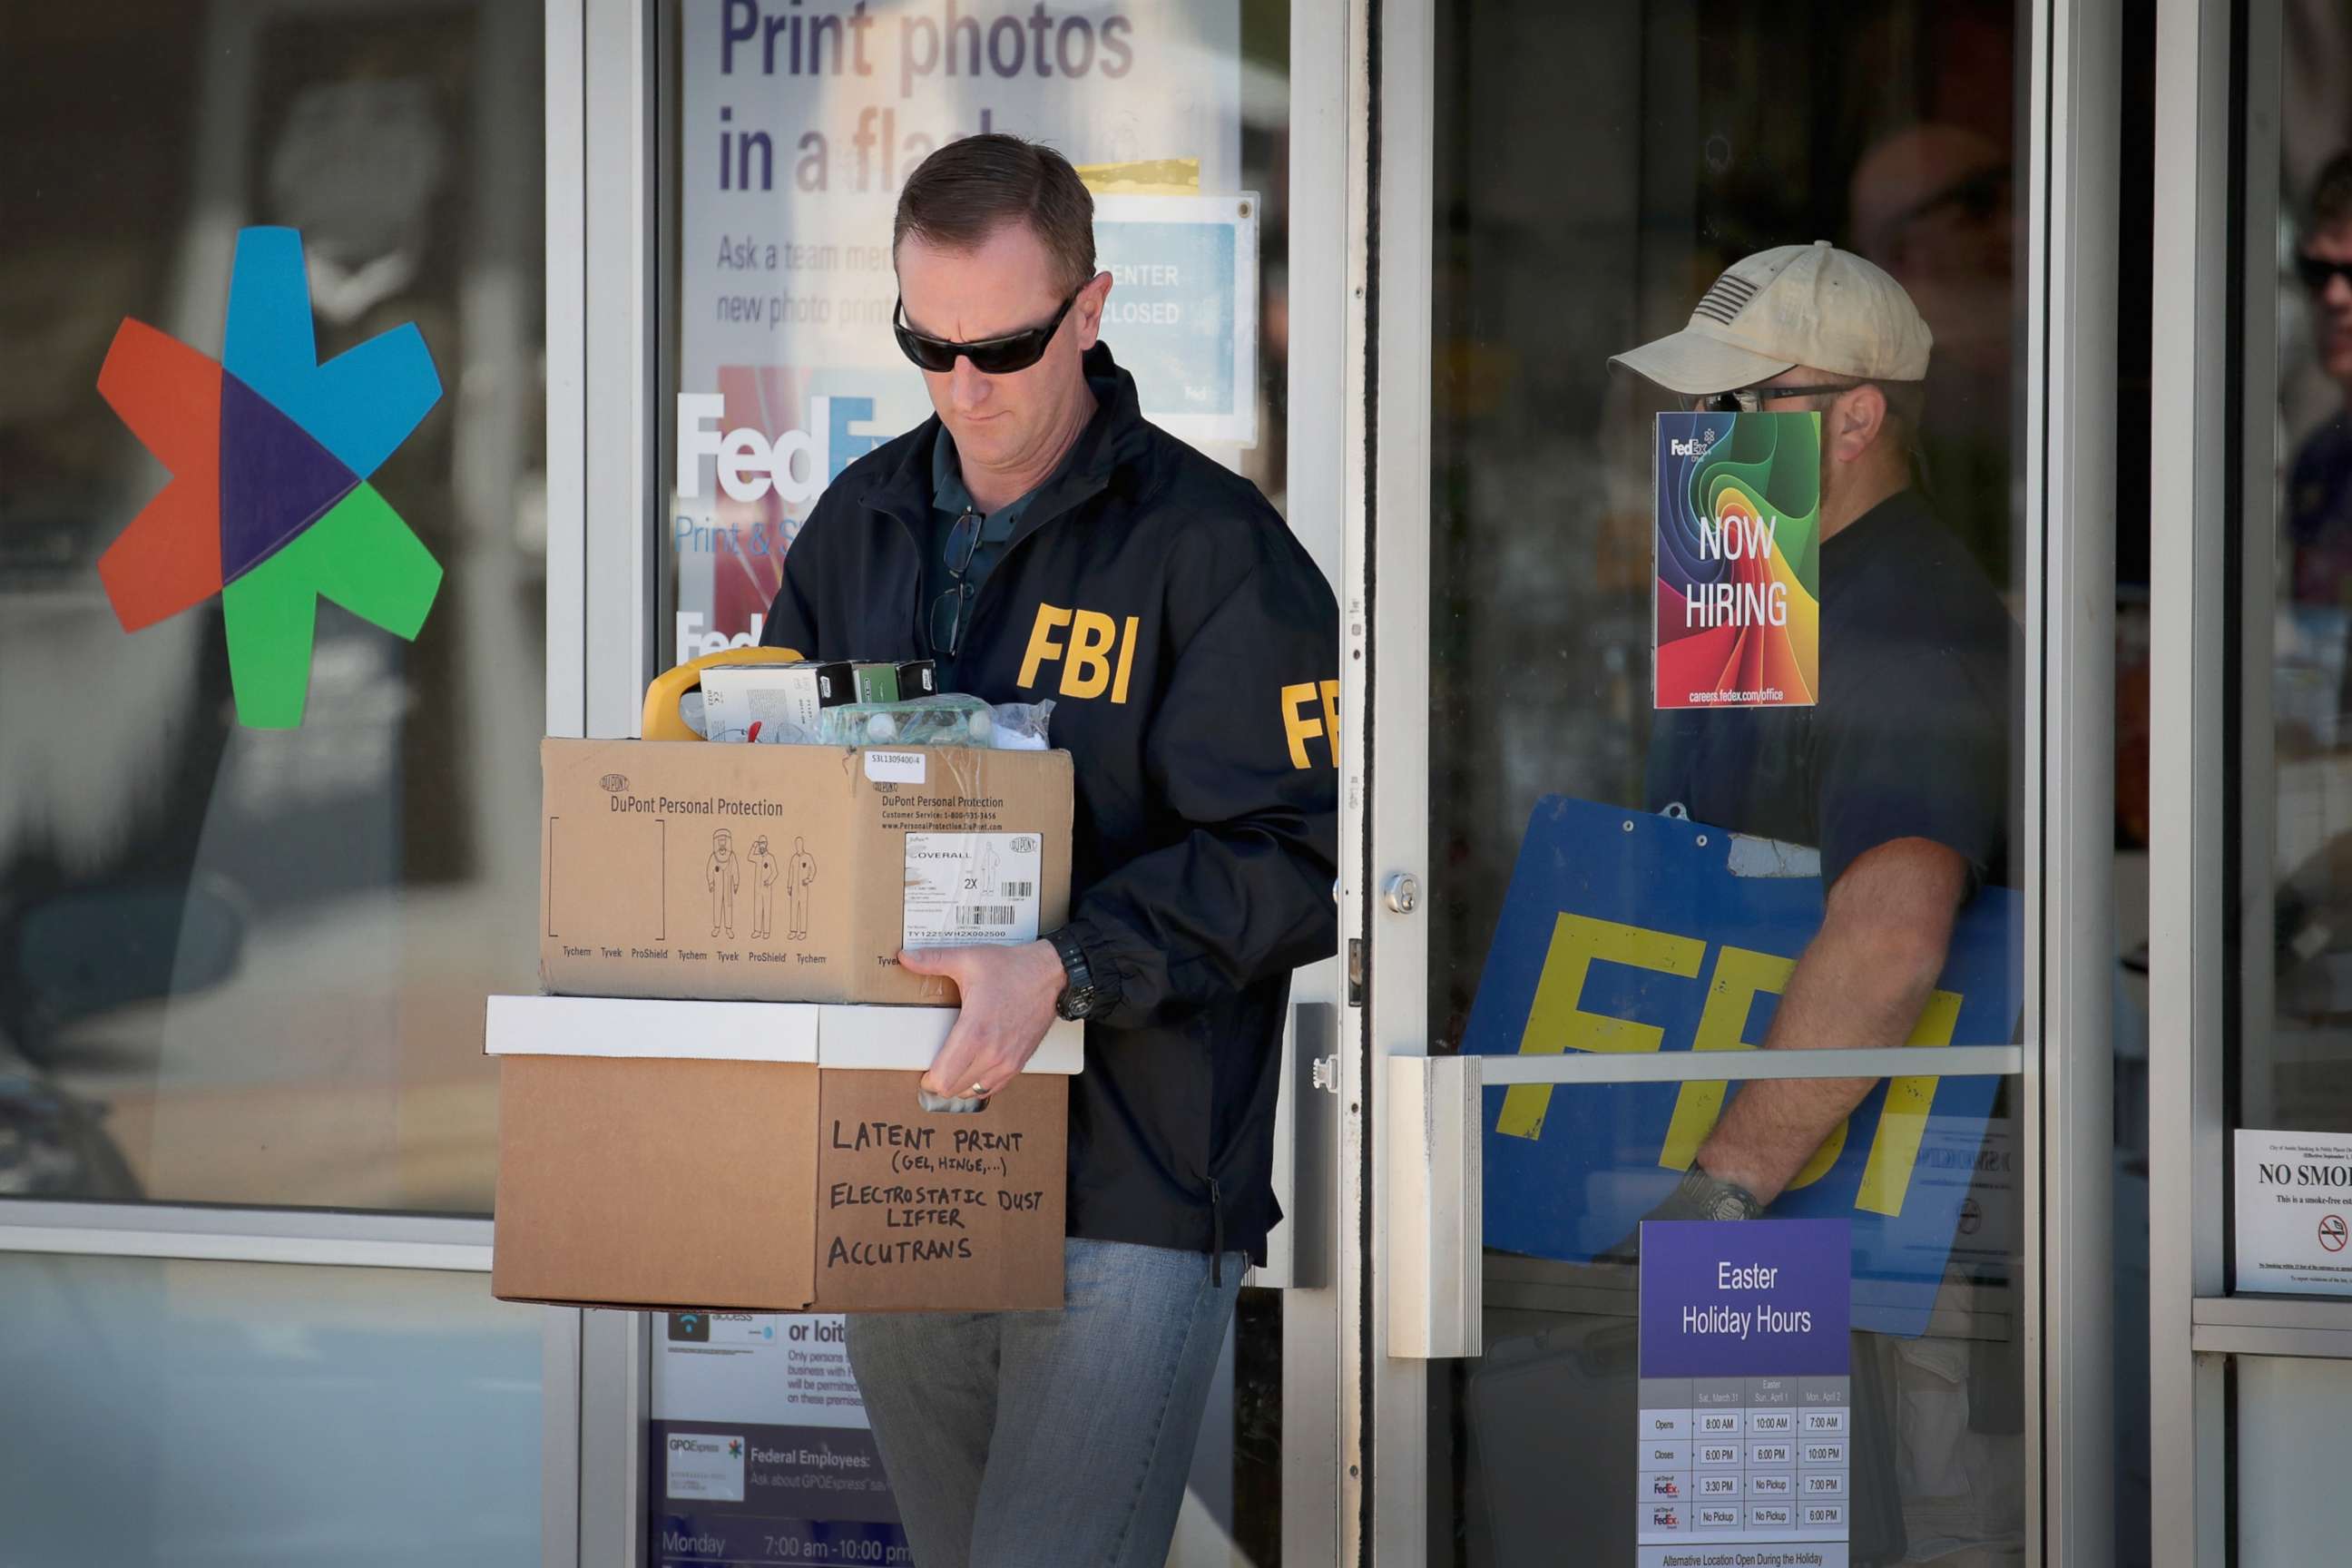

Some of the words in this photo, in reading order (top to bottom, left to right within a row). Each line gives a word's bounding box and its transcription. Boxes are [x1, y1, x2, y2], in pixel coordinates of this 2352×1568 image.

[720, 0, 875, 75] Print
[900, 0, 1134, 98] photos
[720, 106, 773, 191] in
[796, 132, 827, 191] a
[853, 106, 992, 192] fla
[717, 235, 757, 270] Ask
[765, 244, 777, 270] a
[785, 241, 838, 270] team
[717, 295, 761, 321] new
[769, 290, 831, 330] photo
[677, 393, 894, 504] FedE
[1671, 439, 1707, 456] FedEx
[675, 516, 742, 553] Print
[748, 521, 770, 556] &
[1699, 515, 1777, 561] NOW
[1686, 582, 1787, 628] HIRING
[1016, 603, 1140, 704] FBI
[1689, 688, 1784, 703] careers.fedex.com/office
[611, 795, 655, 813] DuPont
[659, 797, 713, 815] Personal
[718, 799, 783, 817] Protection
[882, 796, 915, 807] DuPont
[917, 796, 956, 807] Personal
[957, 797, 1004, 808] Protection
[882, 811, 913, 819] Customer
[916, 811, 942, 819] Service:
[965, 878, 978, 889] 2X
[563, 946, 592, 956] Tychem
[601, 947, 622, 958] Tyvek
[632, 948, 668, 959] ProShield
[678, 949, 707, 962] Tychem
[717, 951, 740, 963] Tyvek
[749, 952, 787, 963] ProShield
[797, 954, 827, 965] Tychem
[877, 956, 901, 967] Tyvek
[832, 1120, 936, 1152] LATENT
[953, 1130, 1023, 1153] PRINT
[892, 1151, 934, 1174] (GEL,
[2259, 1163, 2291, 1185] NO
[830, 1182, 987, 1209] ELECTROSTATIC
[997, 1190, 1044, 1211] DUST
[2277, 1194, 2291, 1203] This
[2292, 1195, 2298, 1203] is
[2305, 1195, 2341, 1205] smoke-free
[887, 1208, 965, 1228] LIFTER
[828, 1237, 972, 1268] ACCUTRANS
[1719, 1261, 1778, 1289] Easter
[1683, 1305, 1751, 1340] Holiday
[1757, 1304, 1811, 1333] Hours
[789, 1324, 808, 1341] or
[789, 1349, 807, 1365] Only
[809, 1352, 843, 1363] persons
[788, 1364, 824, 1377] business
[827, 1367, 846, 1377] with
[788, 1378, 801, 1389] will
[805, 1379, 815, 1390] be
[1763, 1379, 1780, 1389] Easter
[788, 1394, 799, 1404] on
[801, 1394, 824, 1405] these
[1713, 1393, 1730, 1402] March
[1733, 1393, 1739, 1402] 31
[1770, 1392, 1784, 1403] April
[1823, 1392, 1836, 1402] April
[1837, 1391, 1841, 1402] 2
[1655, 1419, 1674, 1431] Opens
[1706, 1419, 1720, 1430] 8:00
[1722, 1418, 1734, 1429] AM
[1757, 1417, 1774, 1429] 10:00
[1776, 1417, 1788, 1428] AM
[1810, 1417, 1825, 1428] 7:00
[1827, 1416, 1838, 1427] AM
[750, 1447, 796, 1464] Federal
[799, 1450, 870, 1468] Employees:
[1655, 1450, 1674, 1460] Closes
[1706, 1450, 1720, 1461] 6:00
[1722, 1449, 1733, 1460] PM
[1758, 1449, 1772, 1460] 6:00
[1774, 1448, 1785, 1459] PM
[1808, 1448, 1826, 1460] 10:00
[1828, 1448, 1839, 1458] PM
[750, 1472, 769, 1485] Ask
[771, 1474, 800, 1488] about
[1706, 1481, 1720, 1492] 3:30
[1722, 1480, 1733, 1491] PM
[1756, 1479, 1765, 1489] No
[1767, 1478, 1786, 1493] Pickup
[1810, 1479, 1824, 1490] 7:00
[1826, 1479, 1837, 1489] PM
[1654, 1483, 1678, 1494] FedEx
[1654, 1514, 1678, 1525] FedEx
[1703, 1512, 1711, 1522] No
[1713, 1511, 1734, 1524] Pickup
[1756, 1511, 1765, 1521] No
[1766, 1510, 1786, 1524] Pickup
[1826, 1510, 1837, 1520] PM
[662, 1531, 725, 1556] Monday
[764, 1536, 799, 1557] 7:00
[804, 1541, 828, 1558] am
[887, 1545, 909, 1563] pm
[1662, 1554, 1701, 1567] Alternative
[1703, 1554, 1734, 1567] Location
[1736, 1553, 1755, 1568] Open
[1757, 1553, 1780, 1568] During
[1782, 1553, 1794, 1563] the
[1796, 1552, 1823, 1567] Holiday
